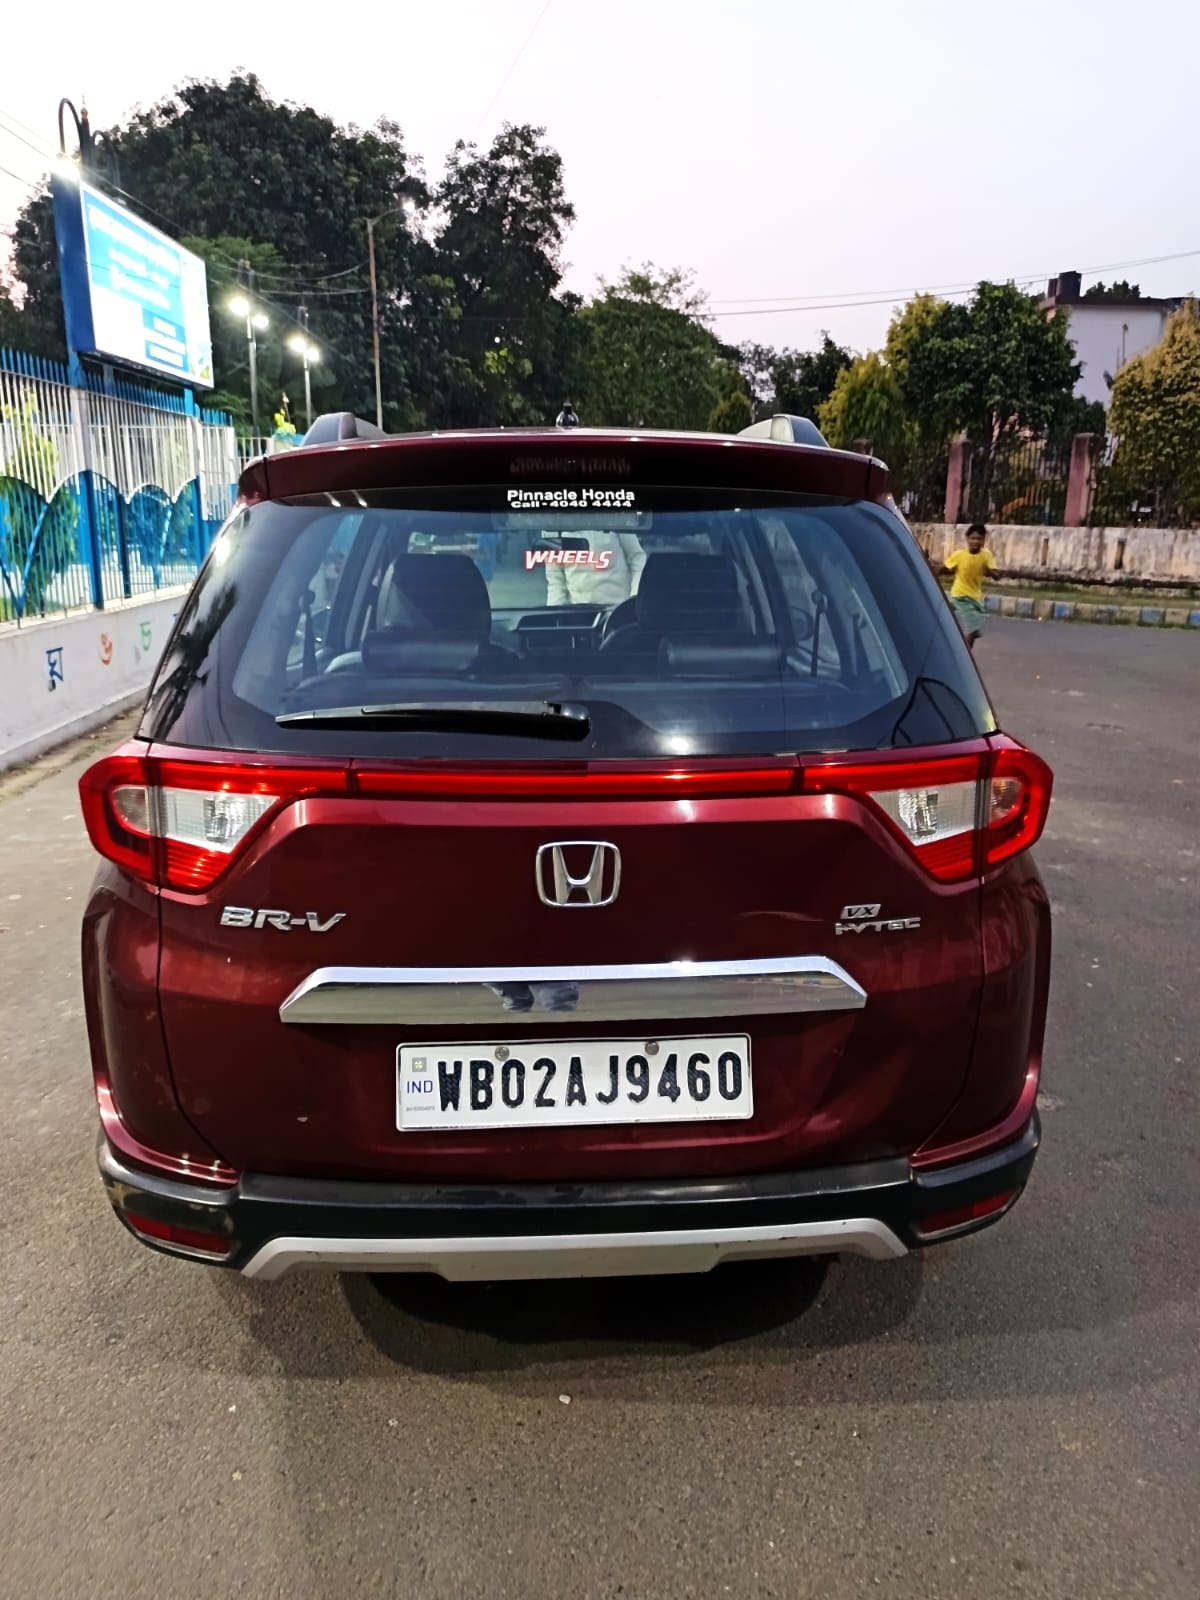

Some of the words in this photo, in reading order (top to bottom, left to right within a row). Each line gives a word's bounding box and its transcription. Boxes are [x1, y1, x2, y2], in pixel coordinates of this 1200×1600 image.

[507, 489, 577, 501] Pinnacle
[582, 488, 635, 501] Honda
[591, 500, 632, 508] 4444
[524, 550, 613, 569] WHEELS
[846, 905, 877, 918] VX
[220, 906, 347, 932] BR-V
[406, 1080, 434, 1094] IND
[437, 1051, 743, 1112] WB02AJ9460
